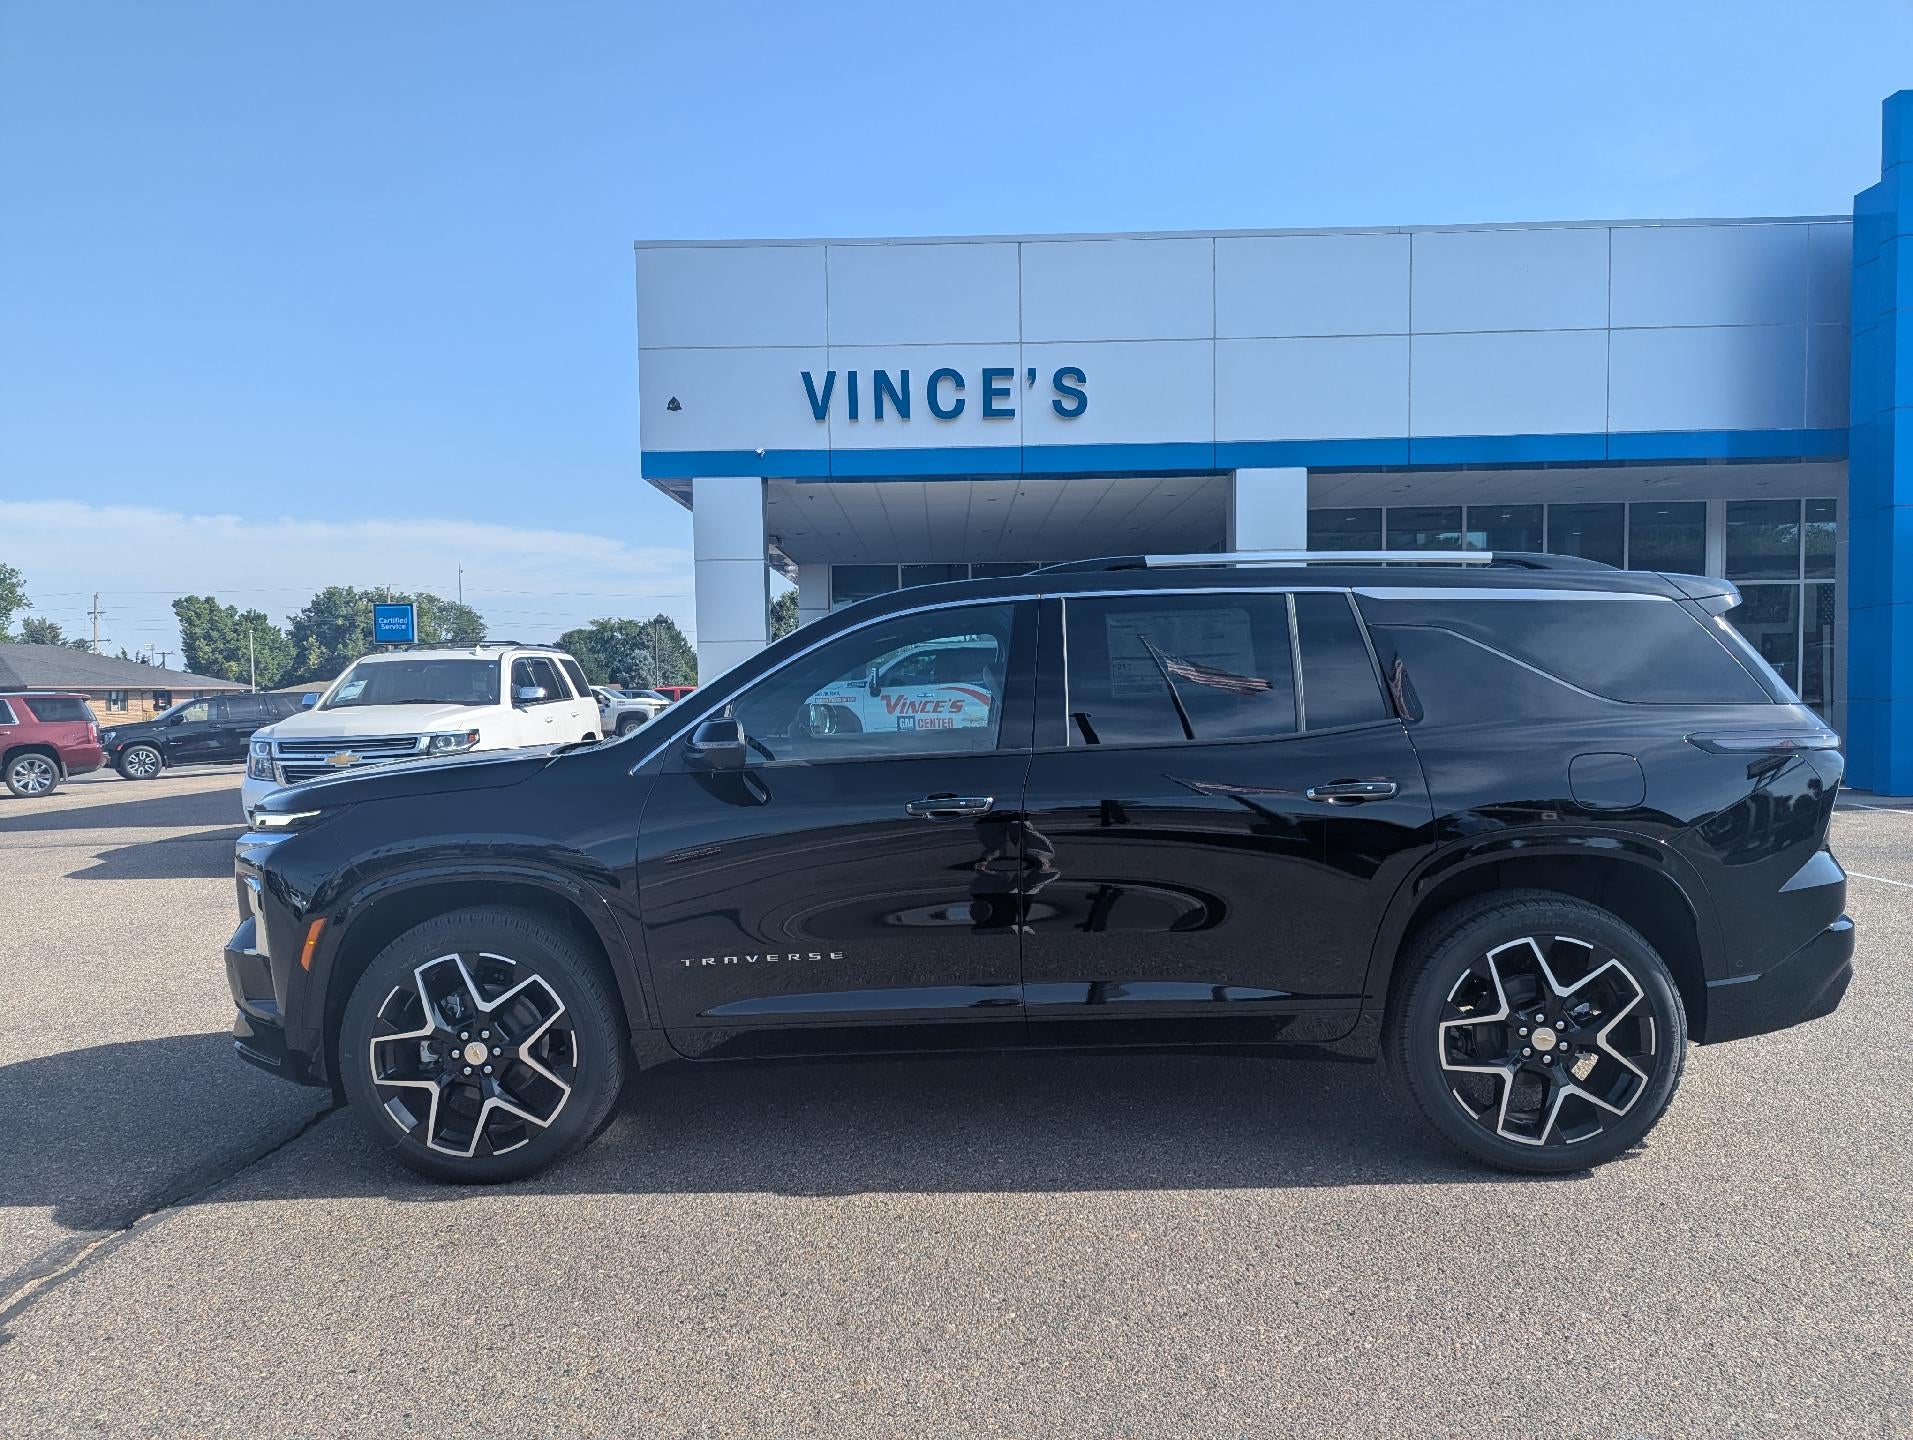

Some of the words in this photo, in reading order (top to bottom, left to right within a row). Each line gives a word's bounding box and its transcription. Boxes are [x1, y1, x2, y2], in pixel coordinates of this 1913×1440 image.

[800, 366, 1088, 421] VINCE'S
[378, 616, 408, 624] Certified
[899, 717, 914, 731] GM
[917, 717, 954, 729] CENTER
[680, 951, 844, 967] TRAVERSE
